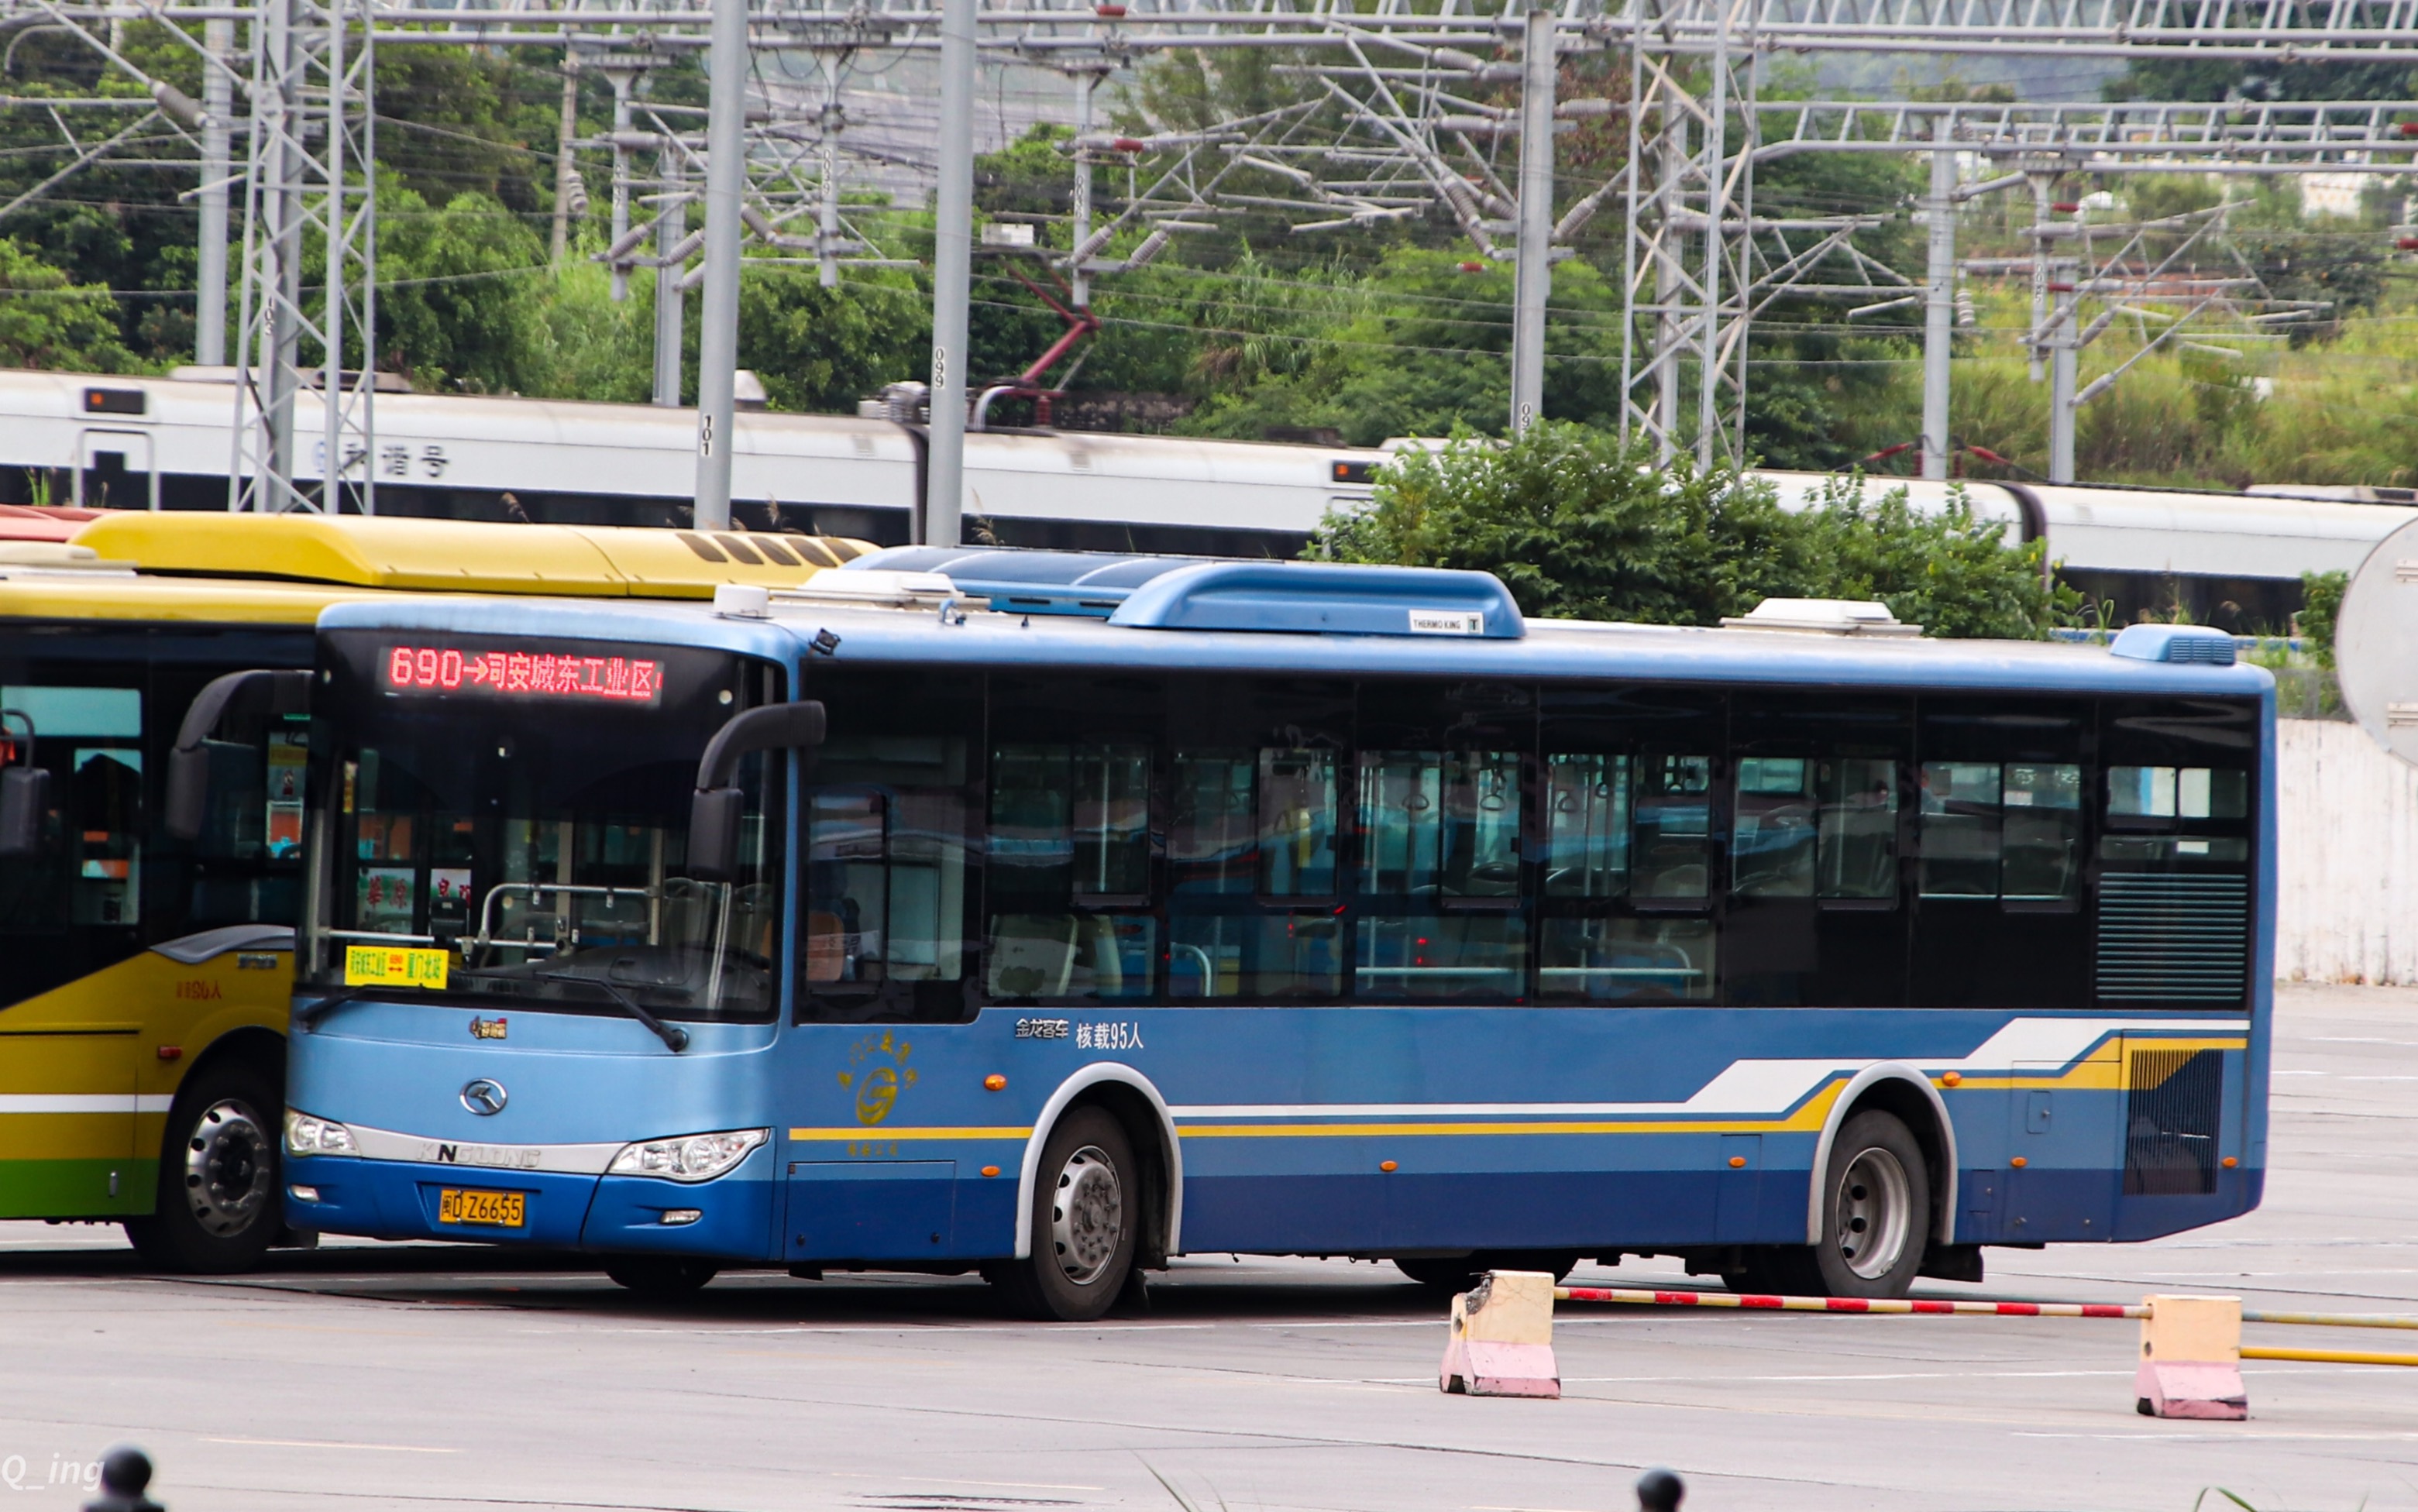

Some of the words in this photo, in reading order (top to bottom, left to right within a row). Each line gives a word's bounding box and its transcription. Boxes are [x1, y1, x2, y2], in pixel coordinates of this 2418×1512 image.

[935, 348, 944, 388] 099
[702, 415, 712, 456] 101
[1413, 619, 1443, 628] THERMO
[1444, 620, 1460, 629] KING
[390, 646, 463, 688] 690
[1015, 1018, 1069, 1039] 金龙客车
[1075, 1021, 1144, 1050] 核载95人
